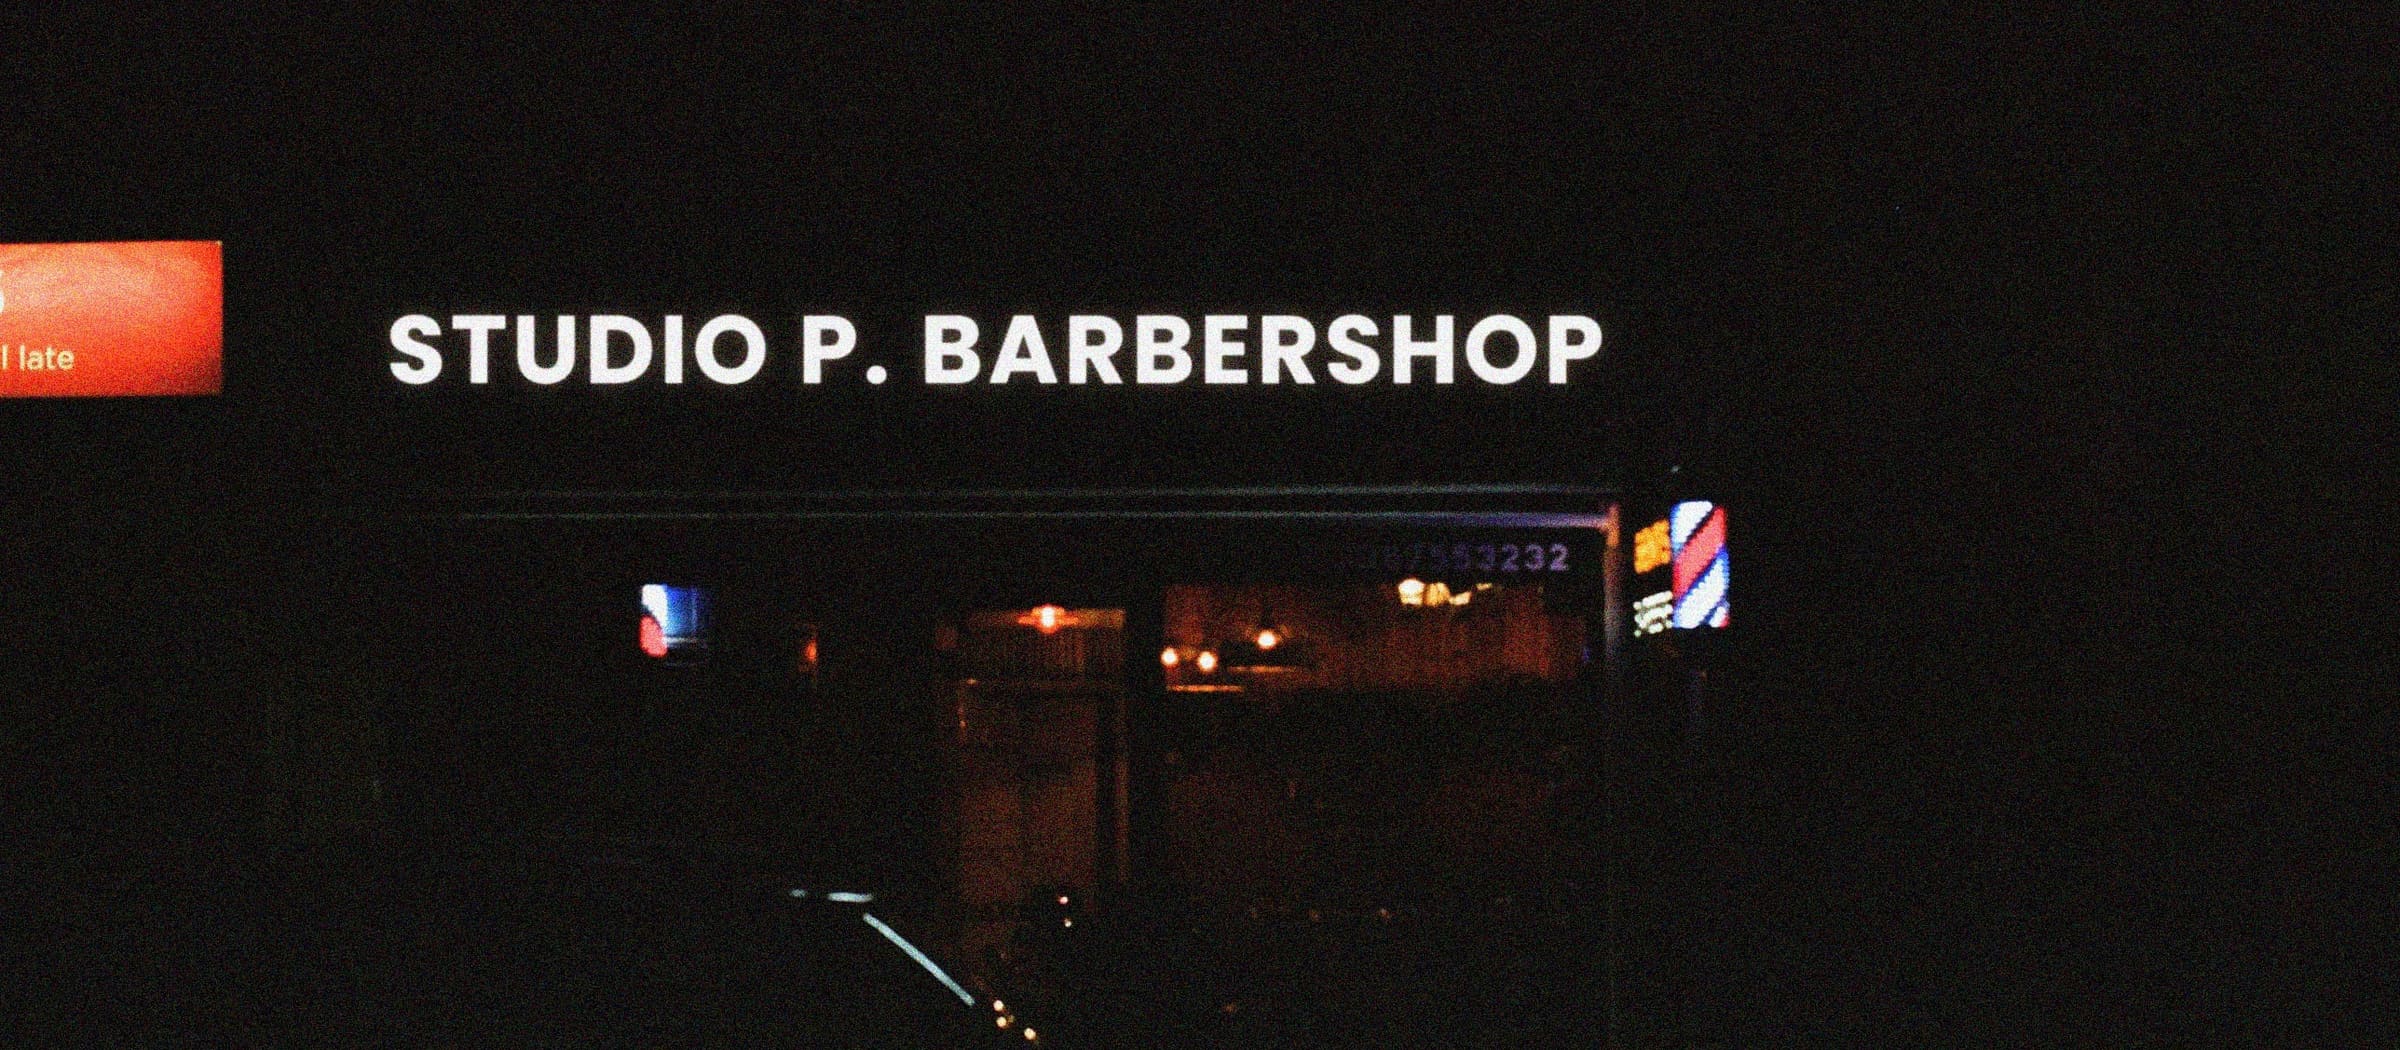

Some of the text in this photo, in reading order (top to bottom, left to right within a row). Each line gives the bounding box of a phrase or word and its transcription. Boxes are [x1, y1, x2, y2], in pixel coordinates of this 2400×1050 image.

[19, 345, 75, 370] late
[389, 313, 1603, 386] STUDIO P. BARBERSHOP
